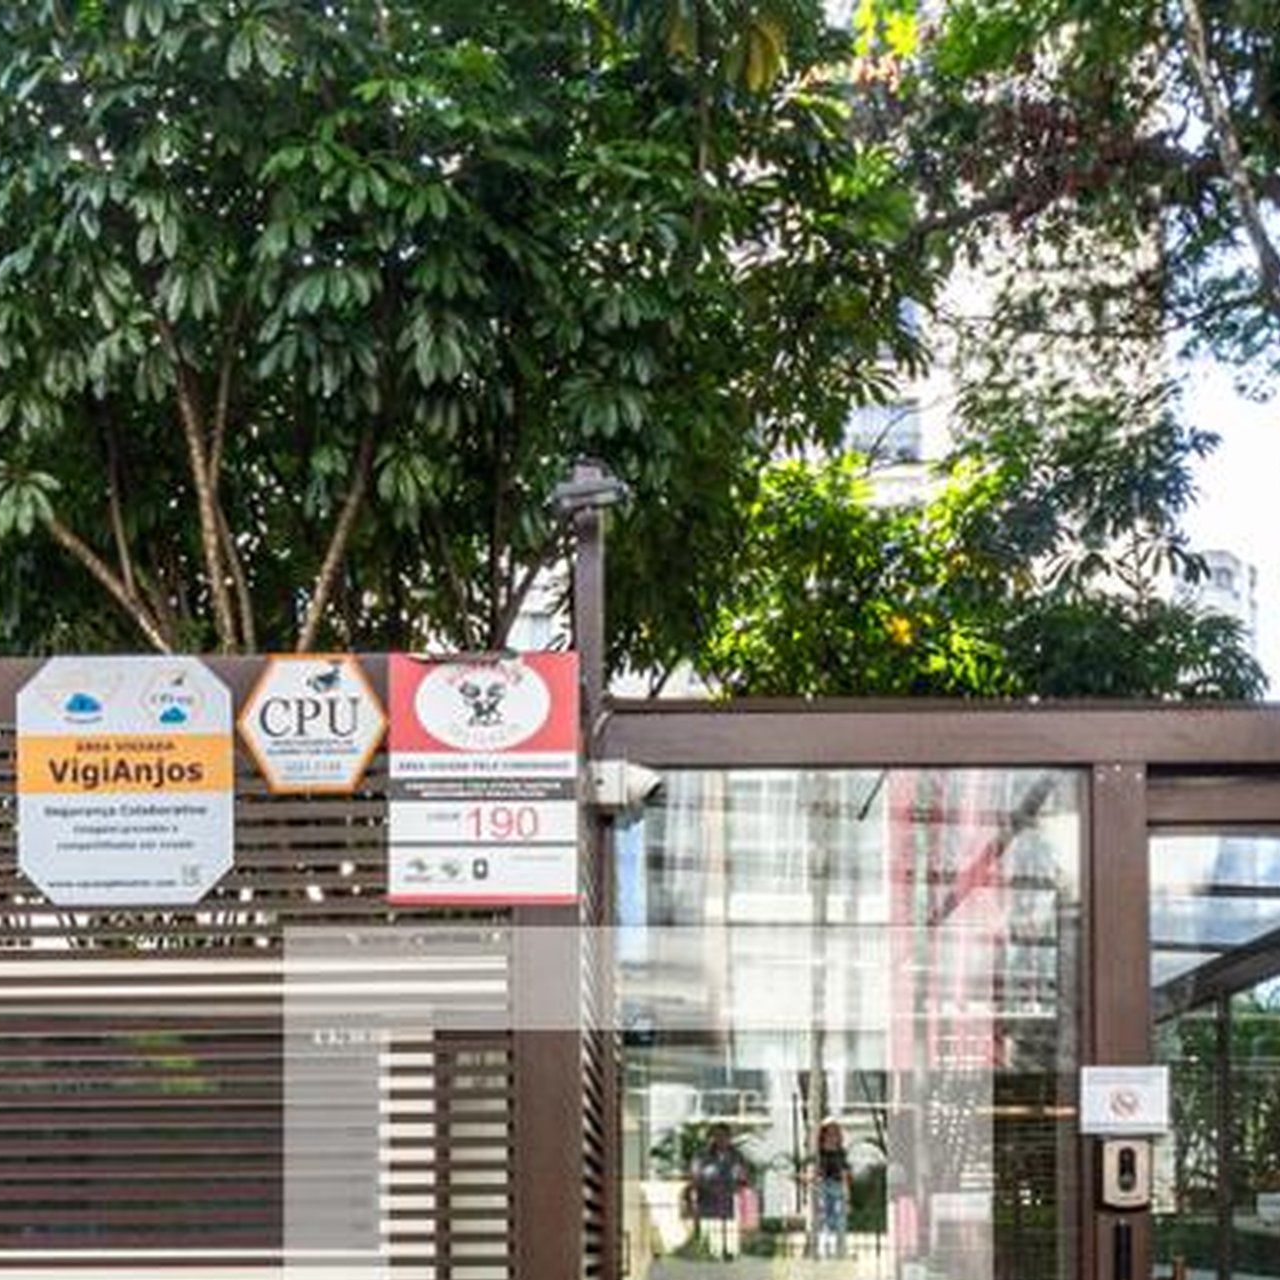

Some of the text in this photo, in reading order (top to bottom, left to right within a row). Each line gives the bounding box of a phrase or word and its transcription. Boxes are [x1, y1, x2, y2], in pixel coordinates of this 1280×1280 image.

[259, 697, 360, 737] CPU
[49, 757, 204, 790] VigiAnjos
[467, 806, 539, 839] 190
